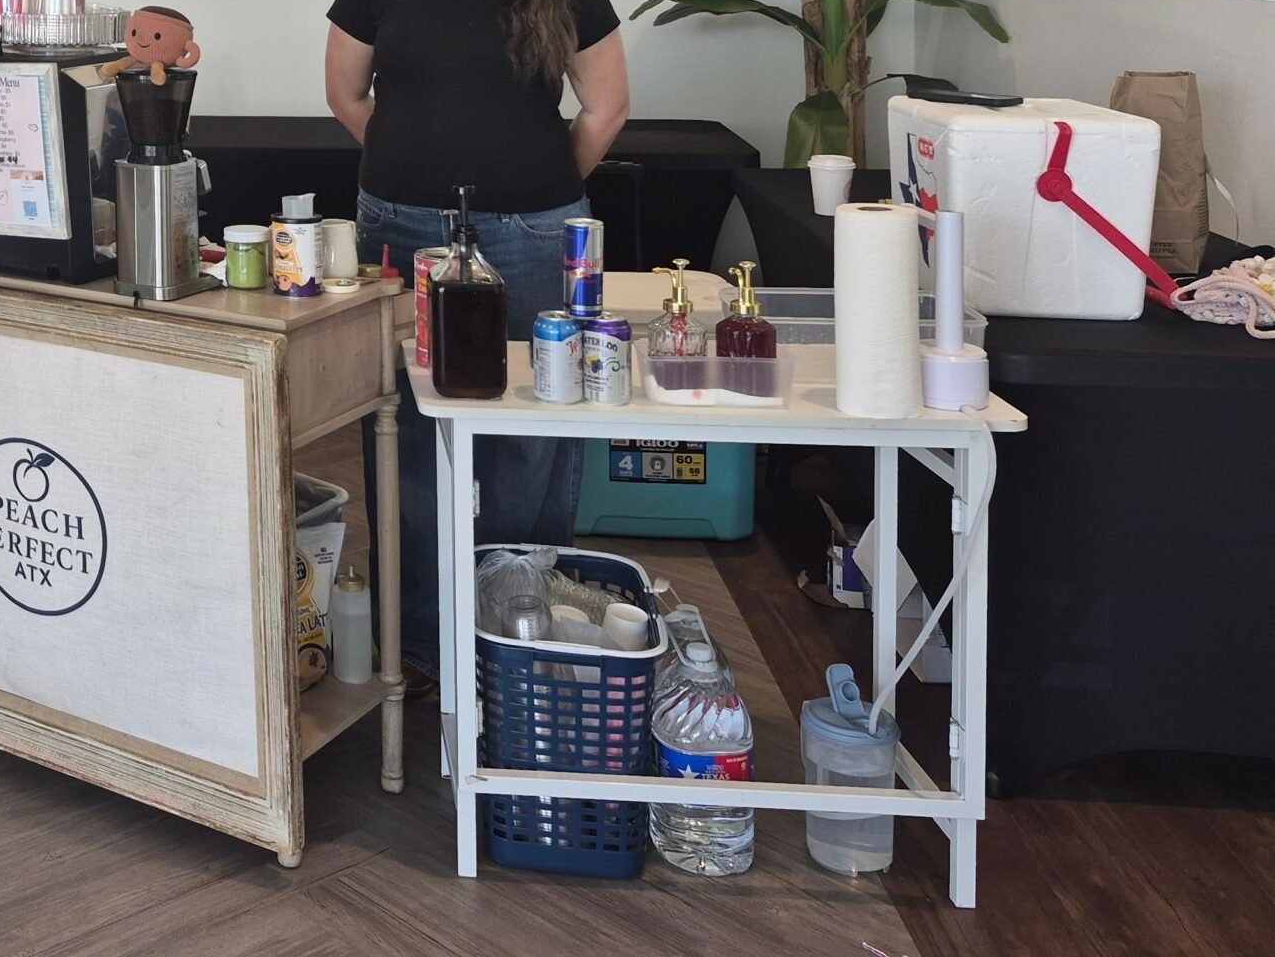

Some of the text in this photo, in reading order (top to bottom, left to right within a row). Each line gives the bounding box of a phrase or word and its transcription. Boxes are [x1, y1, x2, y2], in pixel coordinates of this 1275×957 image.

[0, 77, 20, 87] Menu
[582, 258, 602, 269] Bull
[618, 455, 634, 471] 4
[676, 455, 693, 464] 60
[15, 561, 52, 587] ATX
